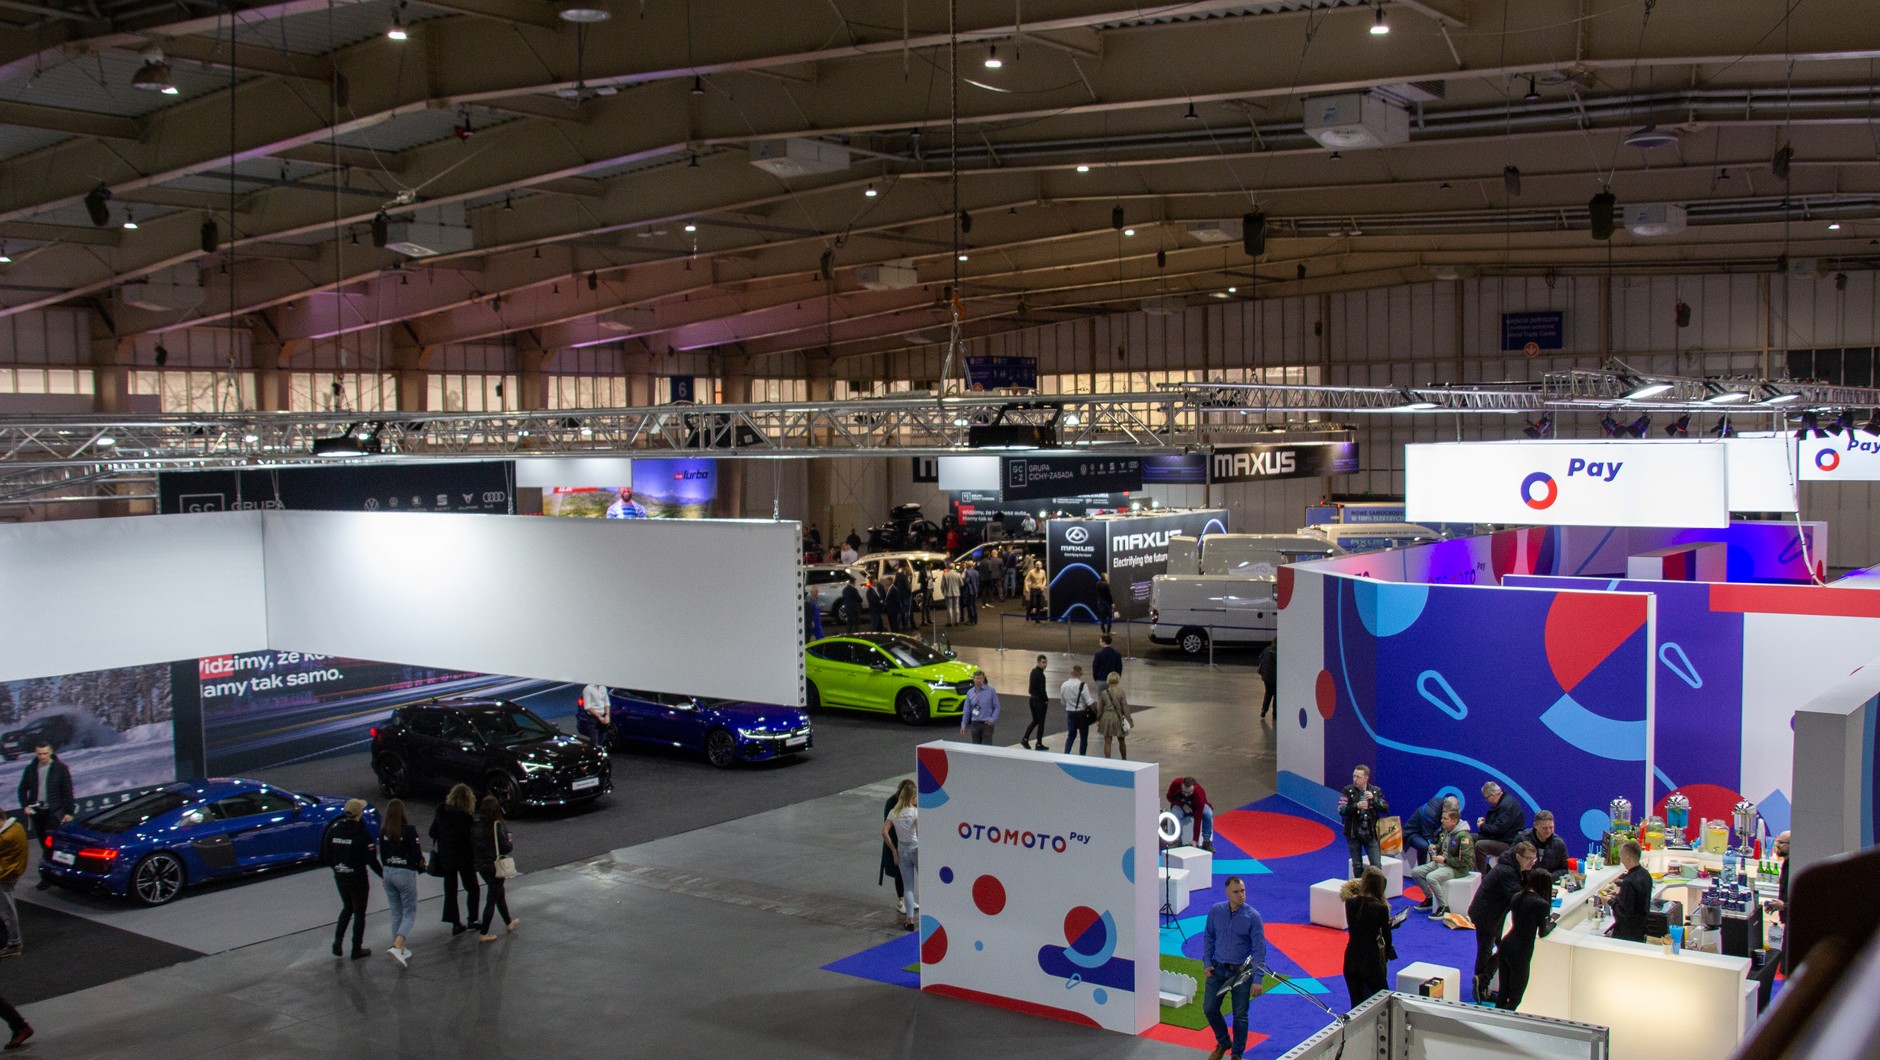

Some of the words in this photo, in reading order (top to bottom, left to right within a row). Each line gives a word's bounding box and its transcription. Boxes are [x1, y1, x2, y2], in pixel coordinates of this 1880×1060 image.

[678, 382, 687, 398] 6
[1847, 440, 1880, 454] Pay
[1028, 464, 1050, 473] GRUPA
[1214, 451, 1296, 477] MAXUS
[1567, 458, 1624, 483] Pay
[1028, 470, 1074, 481] CICHY-ZASADA
[231, 500, 286, 511] GRUPA
[1113, 555, 1144, 568] Electrifying
[1144, 554, 1153, 564] the
[1153, 553, 1168, 563] futur
[1477, 562, 1486, 571] Pay
[277, 651, 300, 666] że
[200, 680, 248, 698] amy
[250, 674, 283, 691] tak
[286, 668, 344, 686] samo.
[958, 822, 1067, 853] OTOMOTO
[1069, 831, 1091, 845] Pay
